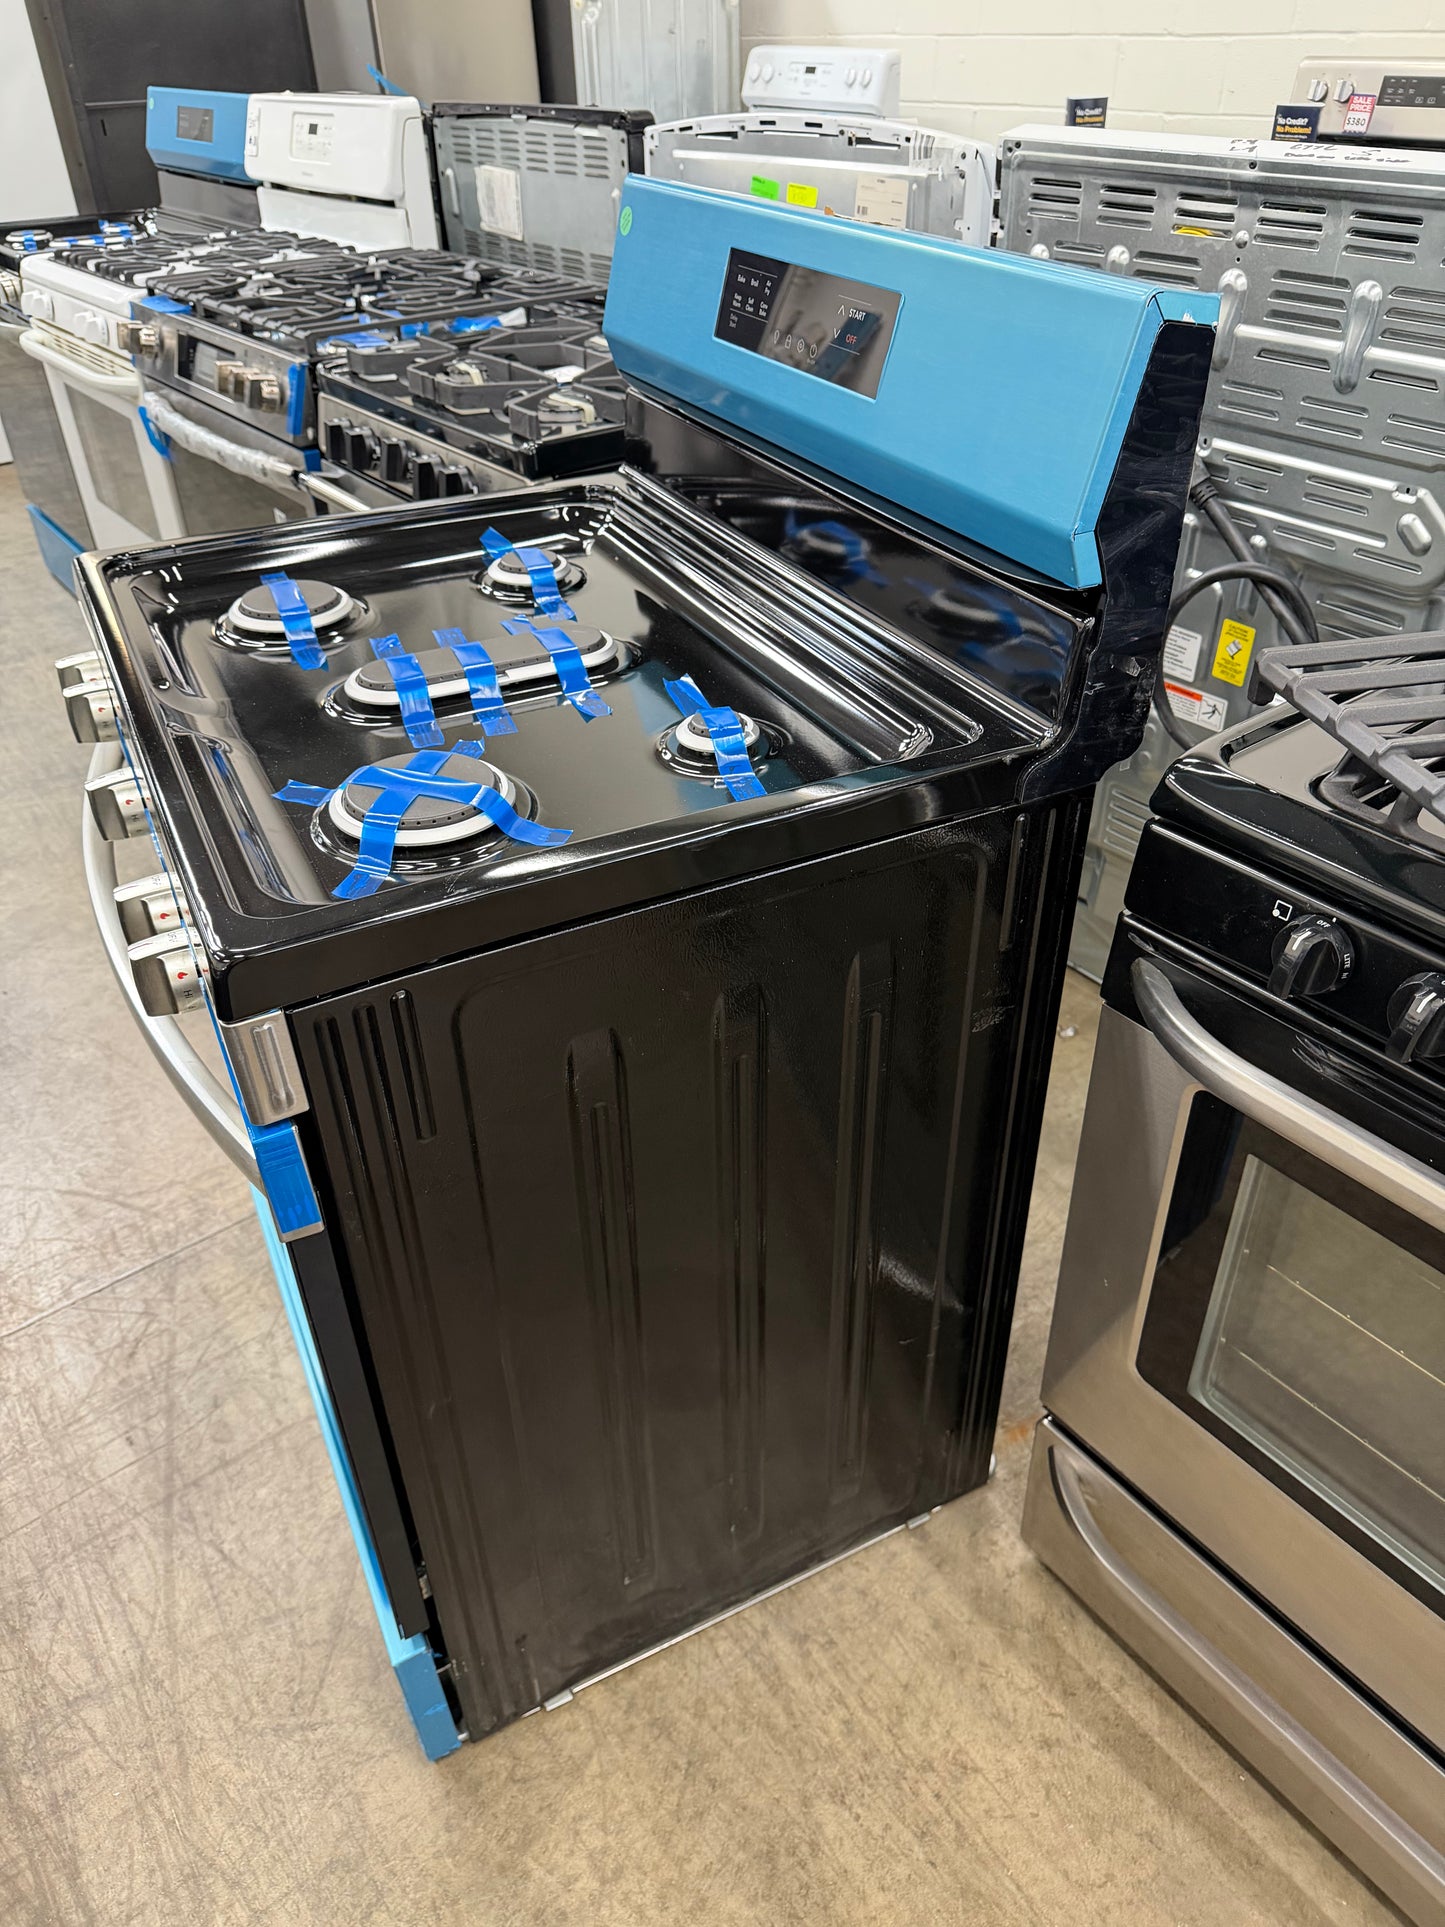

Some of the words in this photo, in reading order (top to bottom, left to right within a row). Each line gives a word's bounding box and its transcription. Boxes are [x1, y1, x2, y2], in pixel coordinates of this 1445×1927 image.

[1353, 96, 1373, 105] SALE
[1350, 103, 1372, 112] PRICE
[1346, 117, 1366, 126] $380
[849, 308, 866, 321] START
[846, 334, 857, 344] OFF
[1316, 919, 1331, 928] OFF
[1343, 953, 1351, 969] LITE
